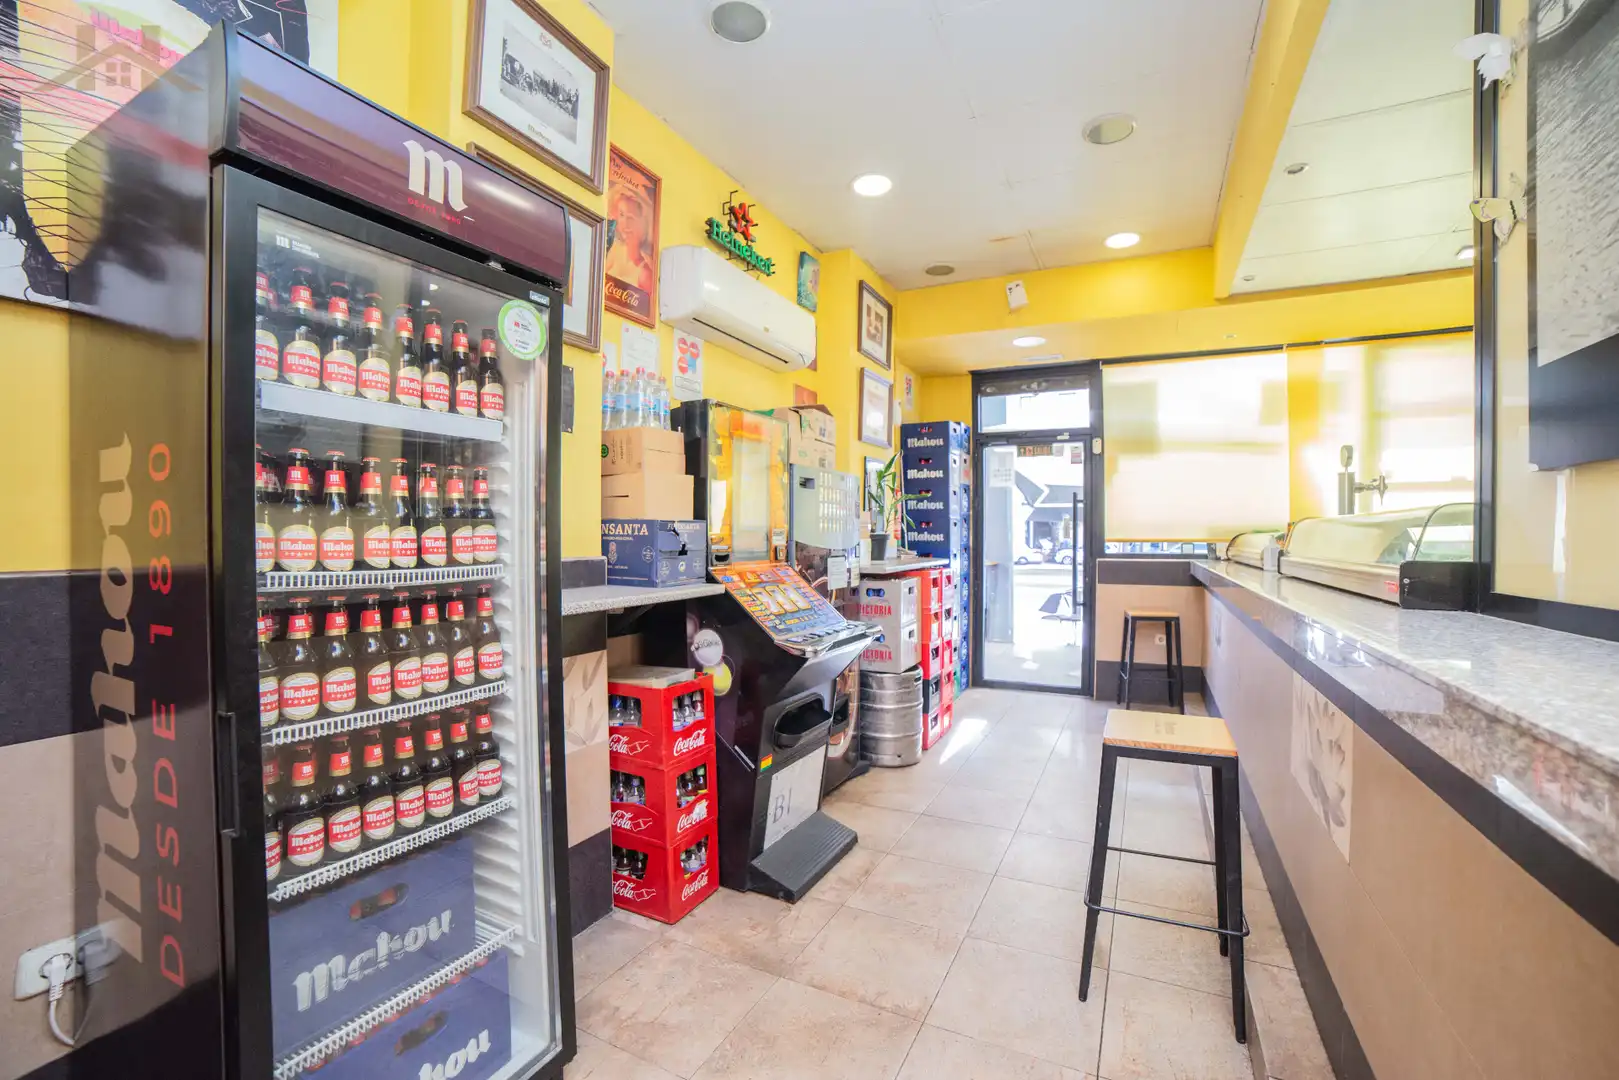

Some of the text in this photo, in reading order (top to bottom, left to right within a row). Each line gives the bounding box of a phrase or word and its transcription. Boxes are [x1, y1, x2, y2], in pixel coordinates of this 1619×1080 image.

[706, 217, 773, 276] Heineken
[907, 437, 944, 448] Mahou
[907, 468, 944, 480] Mahou
[907, 499, 944, 510] Mahou
[907, 531, 944, 542] Mahou
[90, 430, 143, 963] Mahou
[149, 442, 186, 988] DESDE 1890
[673, 728, 707, 757] Coca-Cola
[682, 868, 710, 901] Coca-Cola
